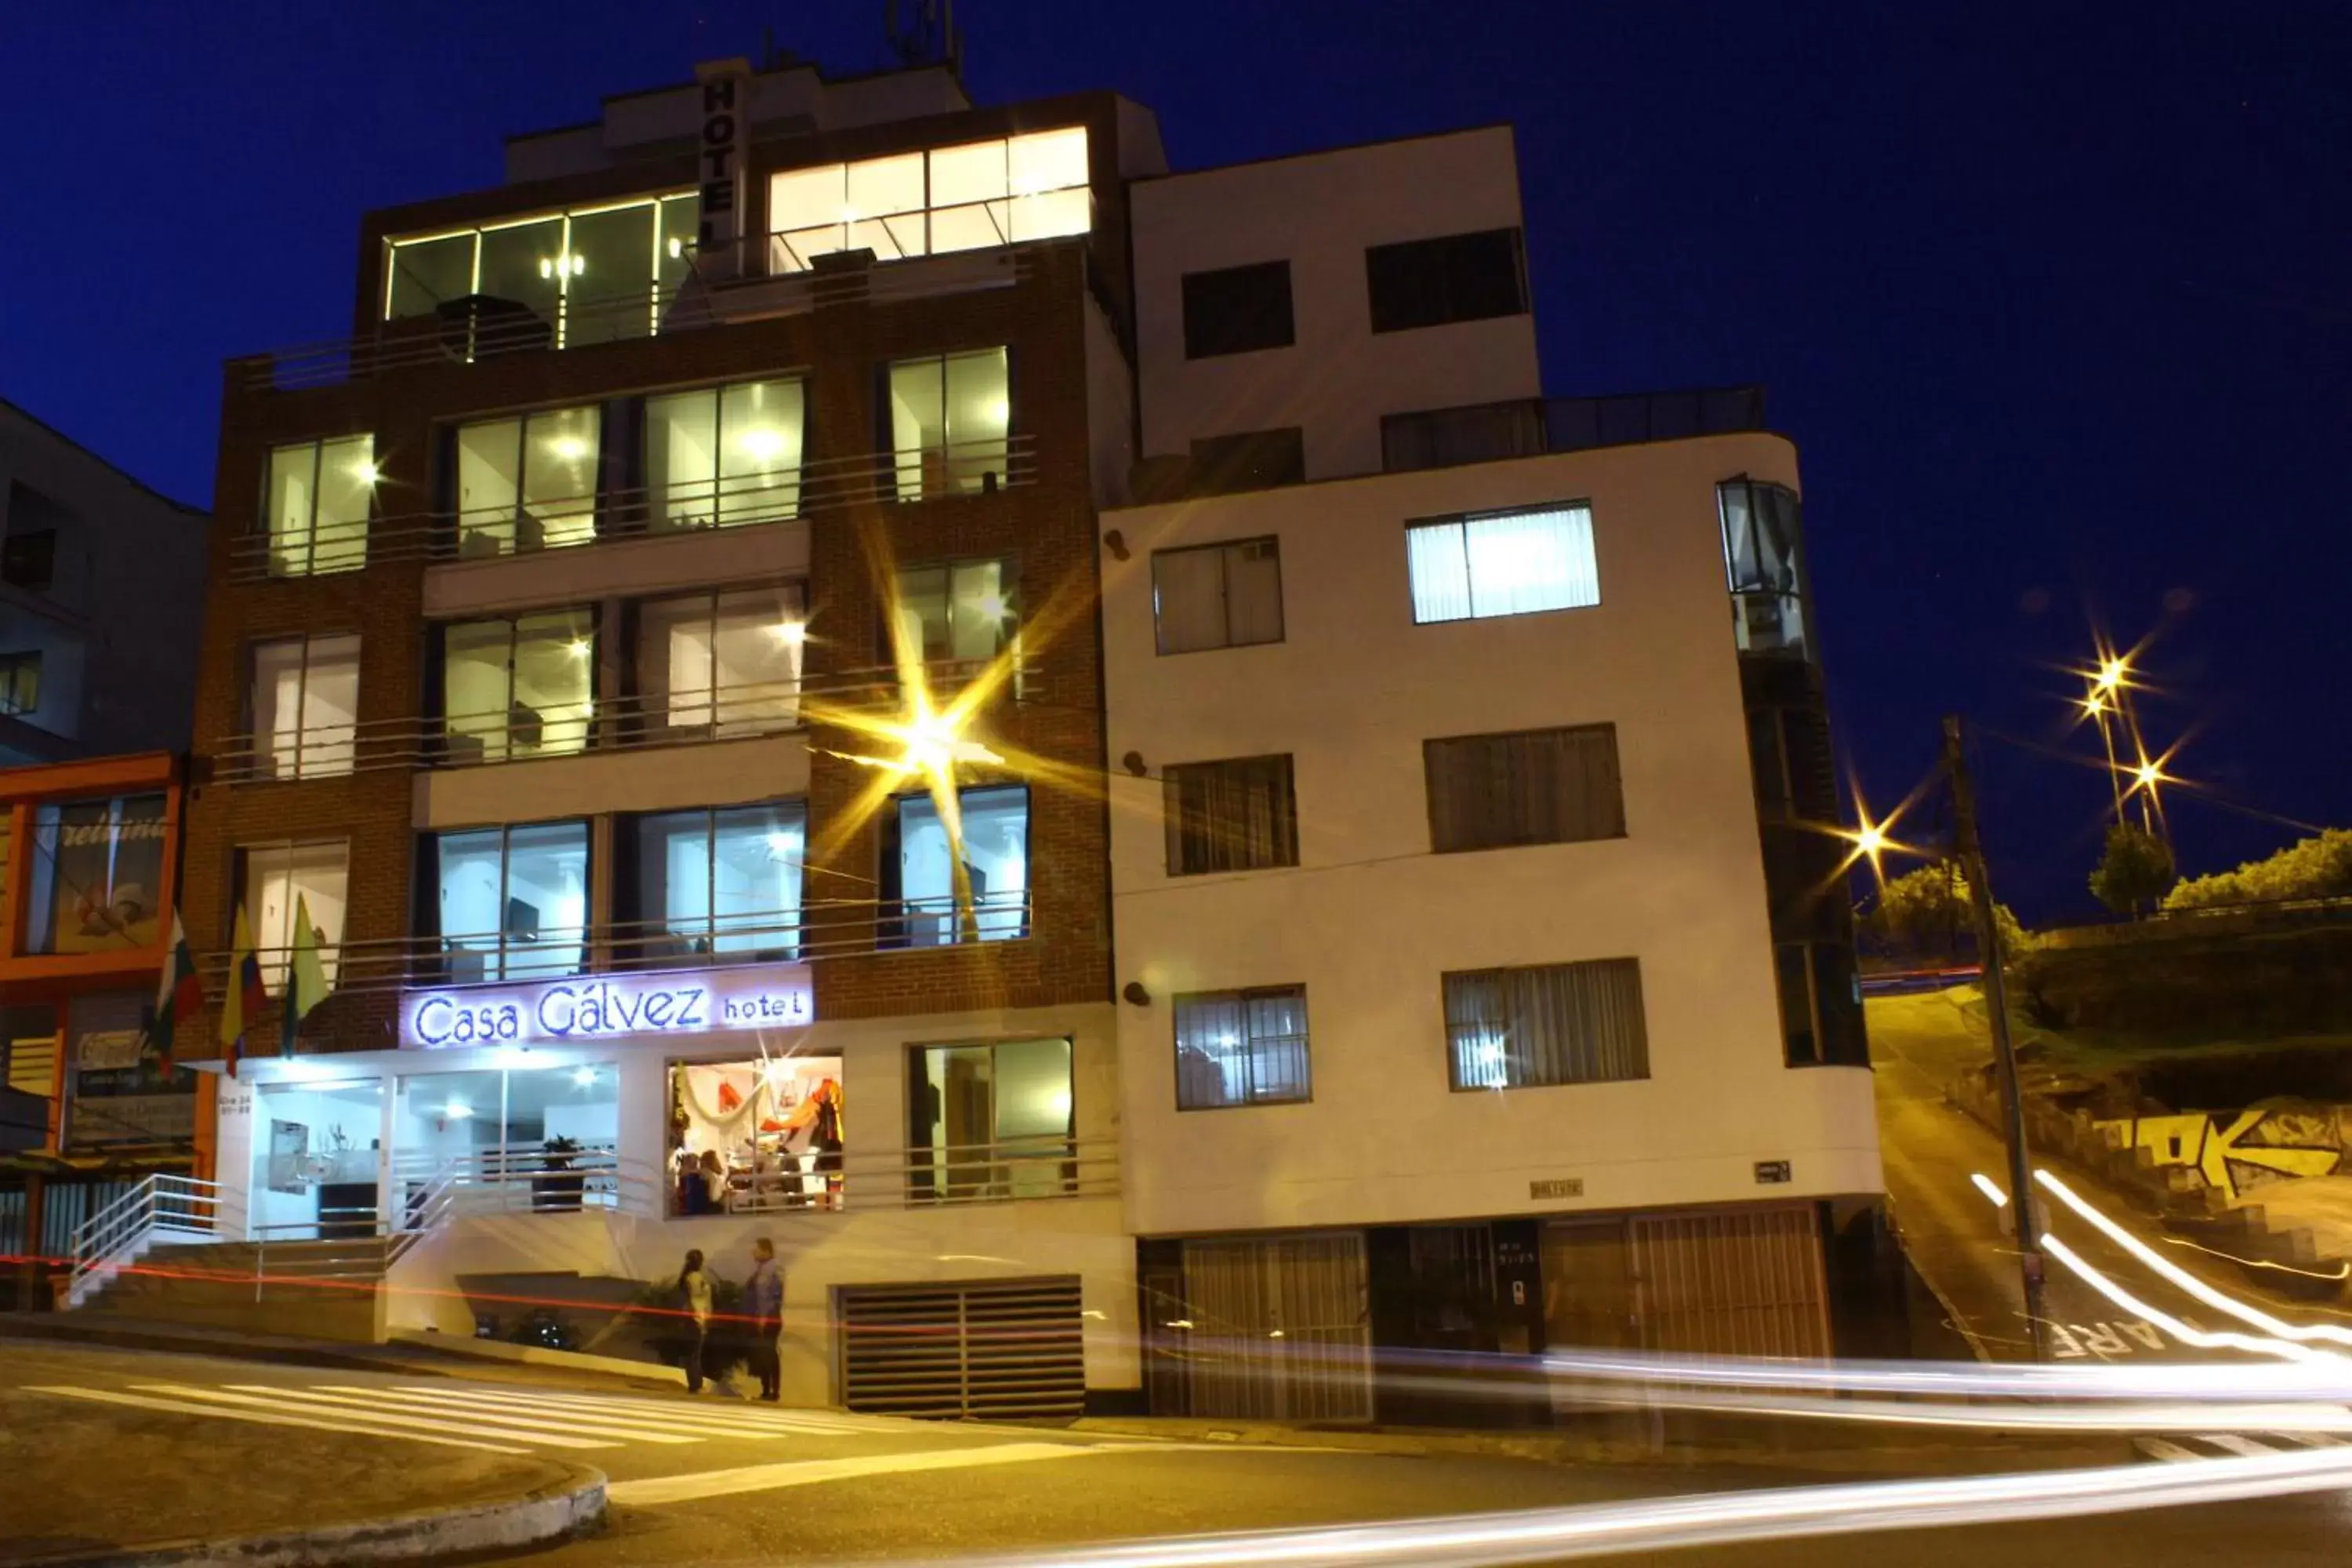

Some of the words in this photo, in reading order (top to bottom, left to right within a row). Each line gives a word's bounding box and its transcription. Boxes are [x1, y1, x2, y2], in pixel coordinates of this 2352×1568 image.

[702, 78, 736, 252] HOTEL
[415, 996, 519, 1044] Casa
[538, 982, 704, 1036] Gálvez
[724, 991, 803, 1019] hotel
